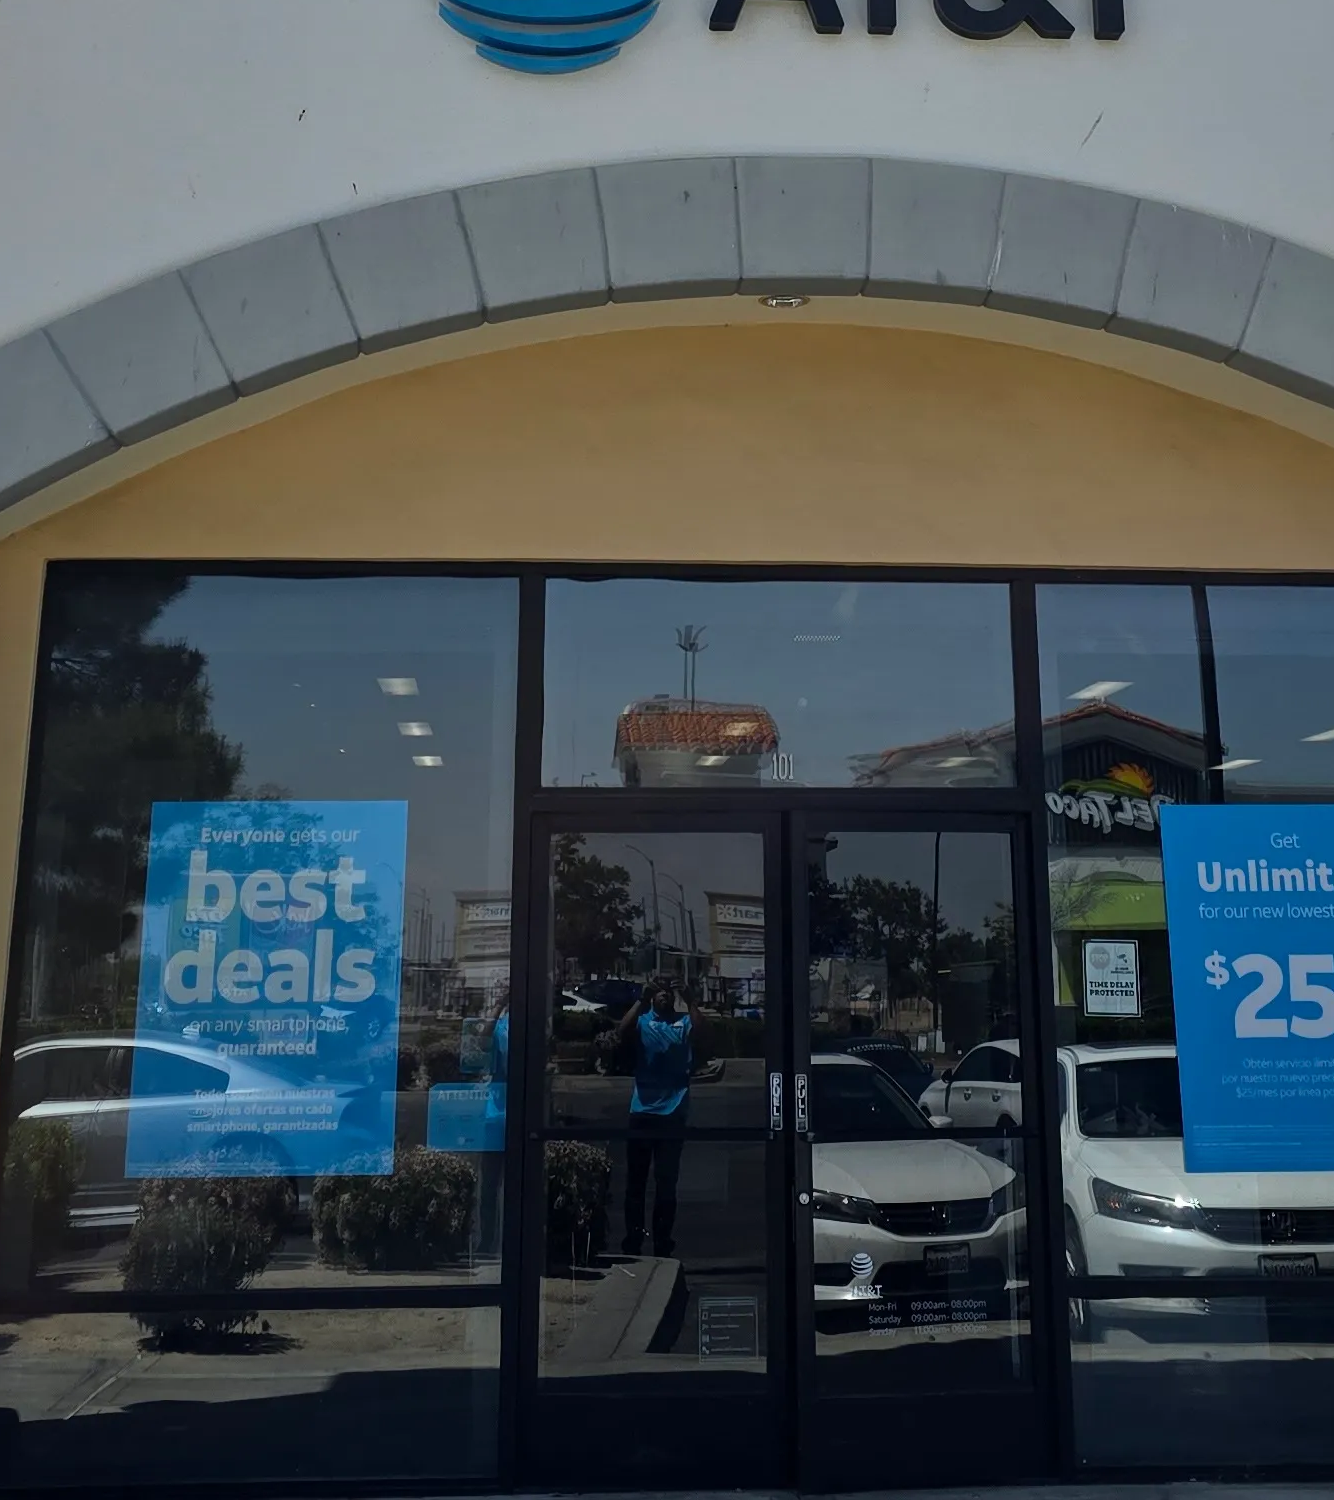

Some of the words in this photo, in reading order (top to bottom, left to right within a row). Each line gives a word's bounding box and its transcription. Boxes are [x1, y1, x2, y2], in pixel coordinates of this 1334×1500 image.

[772, 753, 794, 780] 101
[201, 827, 285, 846] Everyone
[290, 827, 327, 847] gets
[331, 829, 361, 844] our
[1270, 832, 1301, 849] Get
[186, 849, 367, 923] best
[1199, 903, 1220, 919] for
[1224, 906, 1249, 919] our
[1253, 905, 1284, 919] new
[164, 929, 376, 1004] deals
[1089, 981, 1109, 989] TIME
[1110, 981, 1135, 989] DELAY
[1089, 989, 1135, 997] PROTECTED
[192, 1019, 210, 1032] on
[214, 1019, 244, 1036] any
[247, 1015, 350, 1037] smartphone,
[218, 1039, 317, 1058] guaranteed
[1222, 1074, 1237, 1085] por
[1240, 1073, 1278, 1083] nuestro
[1280, 1074, 1309, 1083] nuevo
[1280, 1088, 1296, 1100] por
[243, 1104, 287, 1116] ofertas
[288, 1106, 303, 1115] en
[305, 1104, 333, 1115] cada
[186, 1119, 261, 1135] smartphone,
[263, 1119, 339, 1134] garantizadas
[868, 1301, 897, 1312] Mon-Fri
[868, 1315, 901, 1325] Saturday
